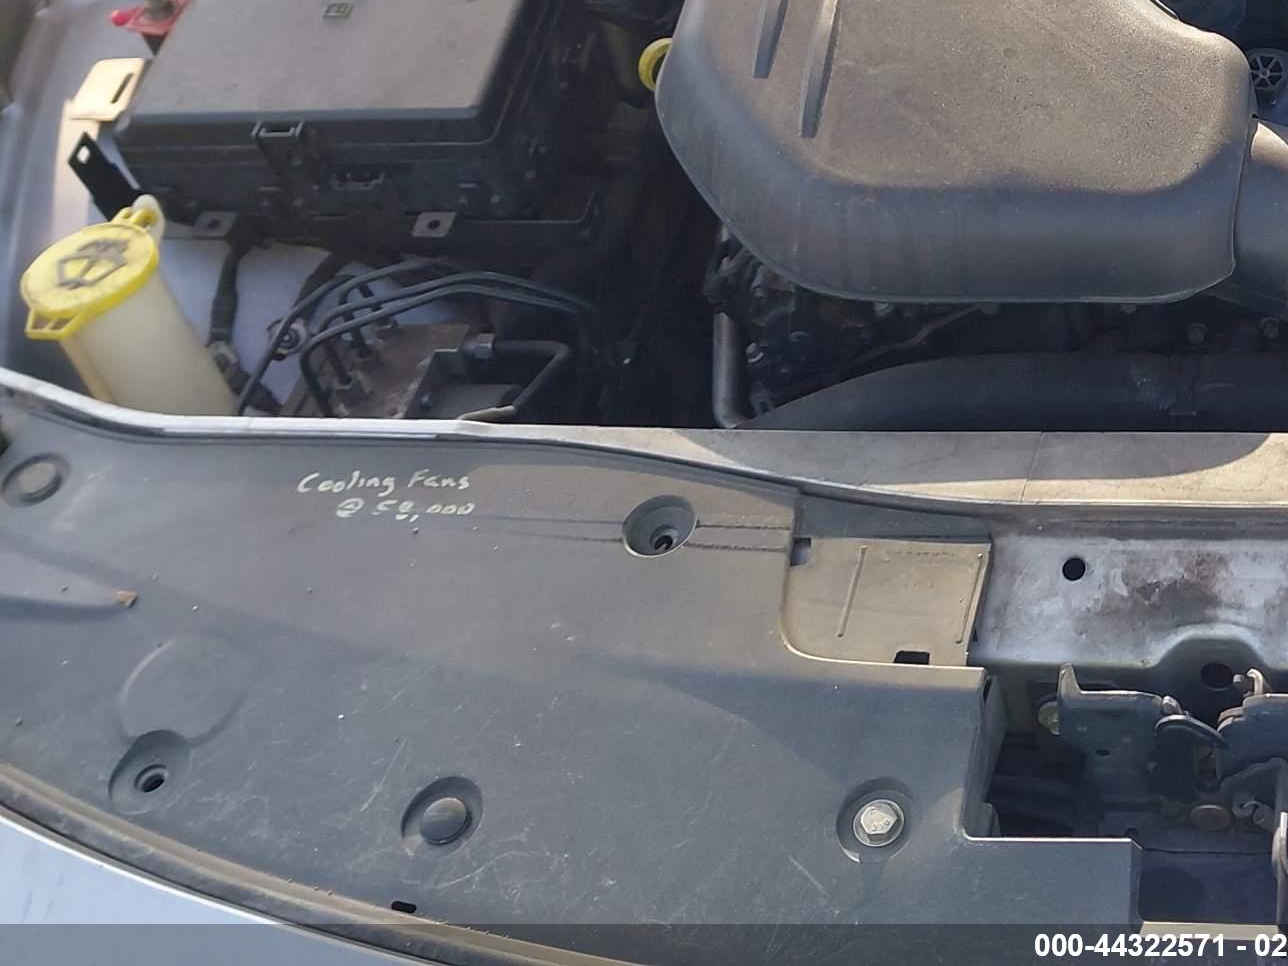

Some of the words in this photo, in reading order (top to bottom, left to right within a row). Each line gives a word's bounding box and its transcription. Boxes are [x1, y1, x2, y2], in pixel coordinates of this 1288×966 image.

[297, 470, 396, 497] Cooling
[407, 468, 471, 490] Fans
[335, 497, 365, 518] @
